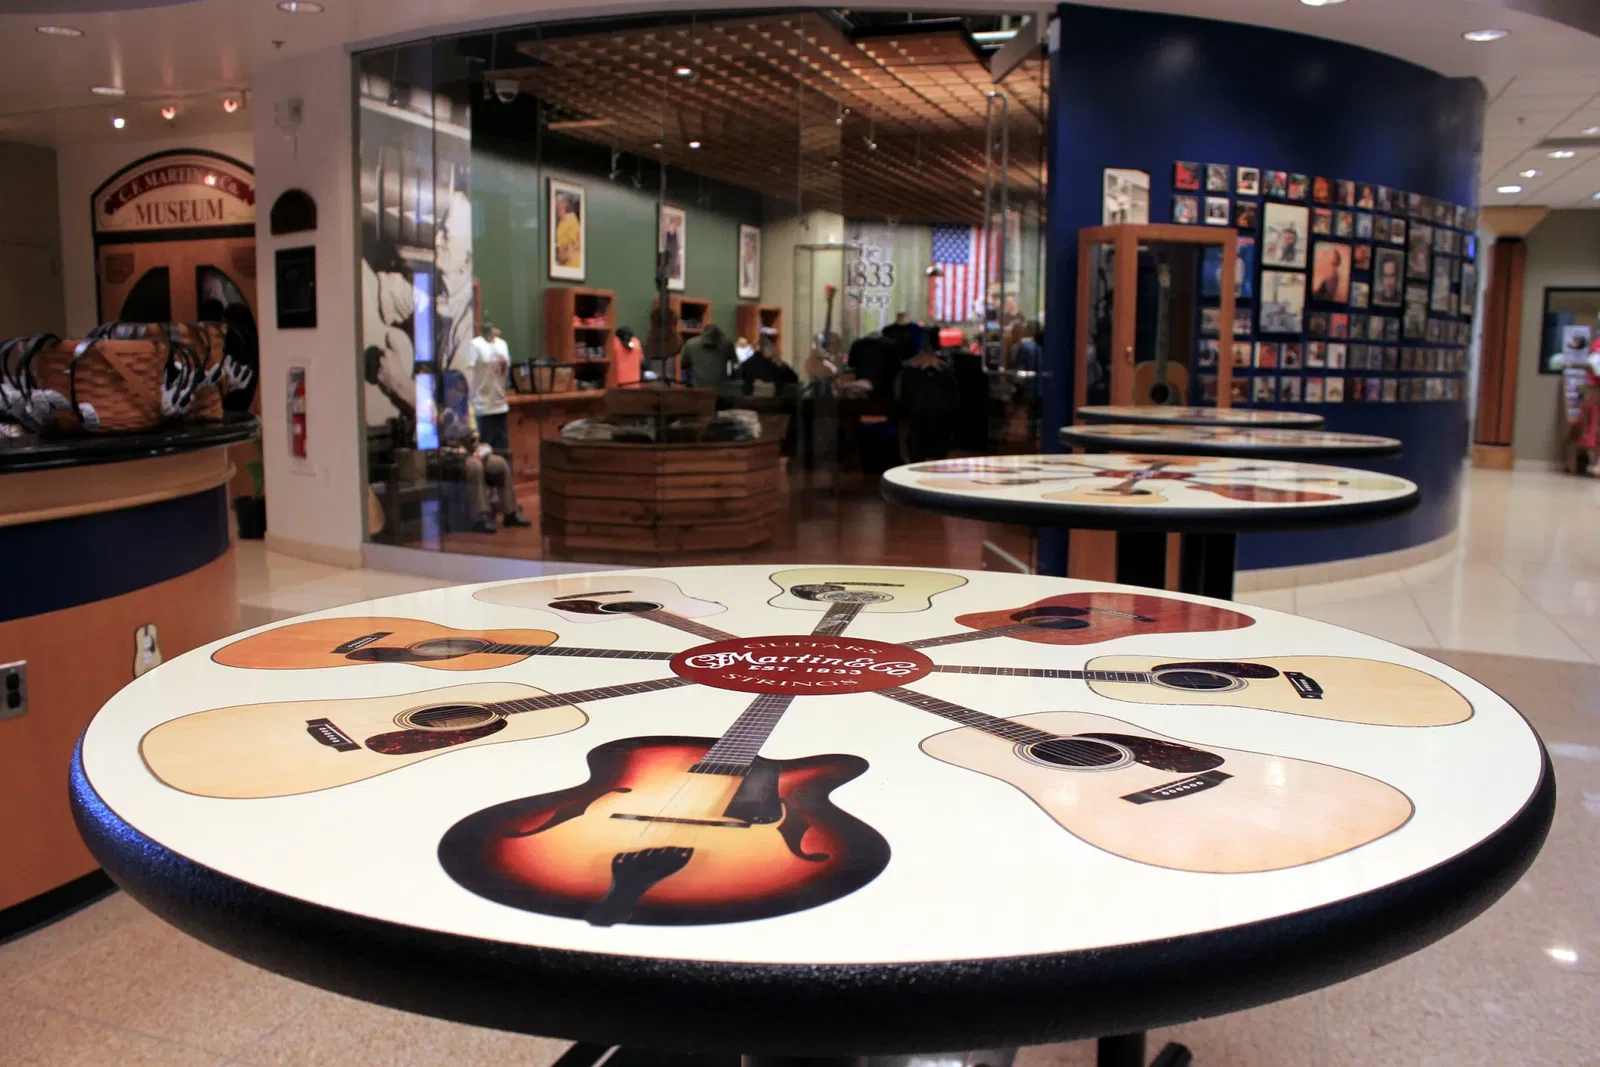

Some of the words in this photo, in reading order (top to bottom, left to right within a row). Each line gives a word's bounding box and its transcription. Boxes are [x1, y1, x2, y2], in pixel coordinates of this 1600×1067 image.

[135, 197, 224, 225] MUSEUM
[847, 261, 894, 288] 1833
[743, 642, 882, 654] GUITARS
[748, 664, 796, 672] EST.
[721, 673, 858, 687] STRINGS
